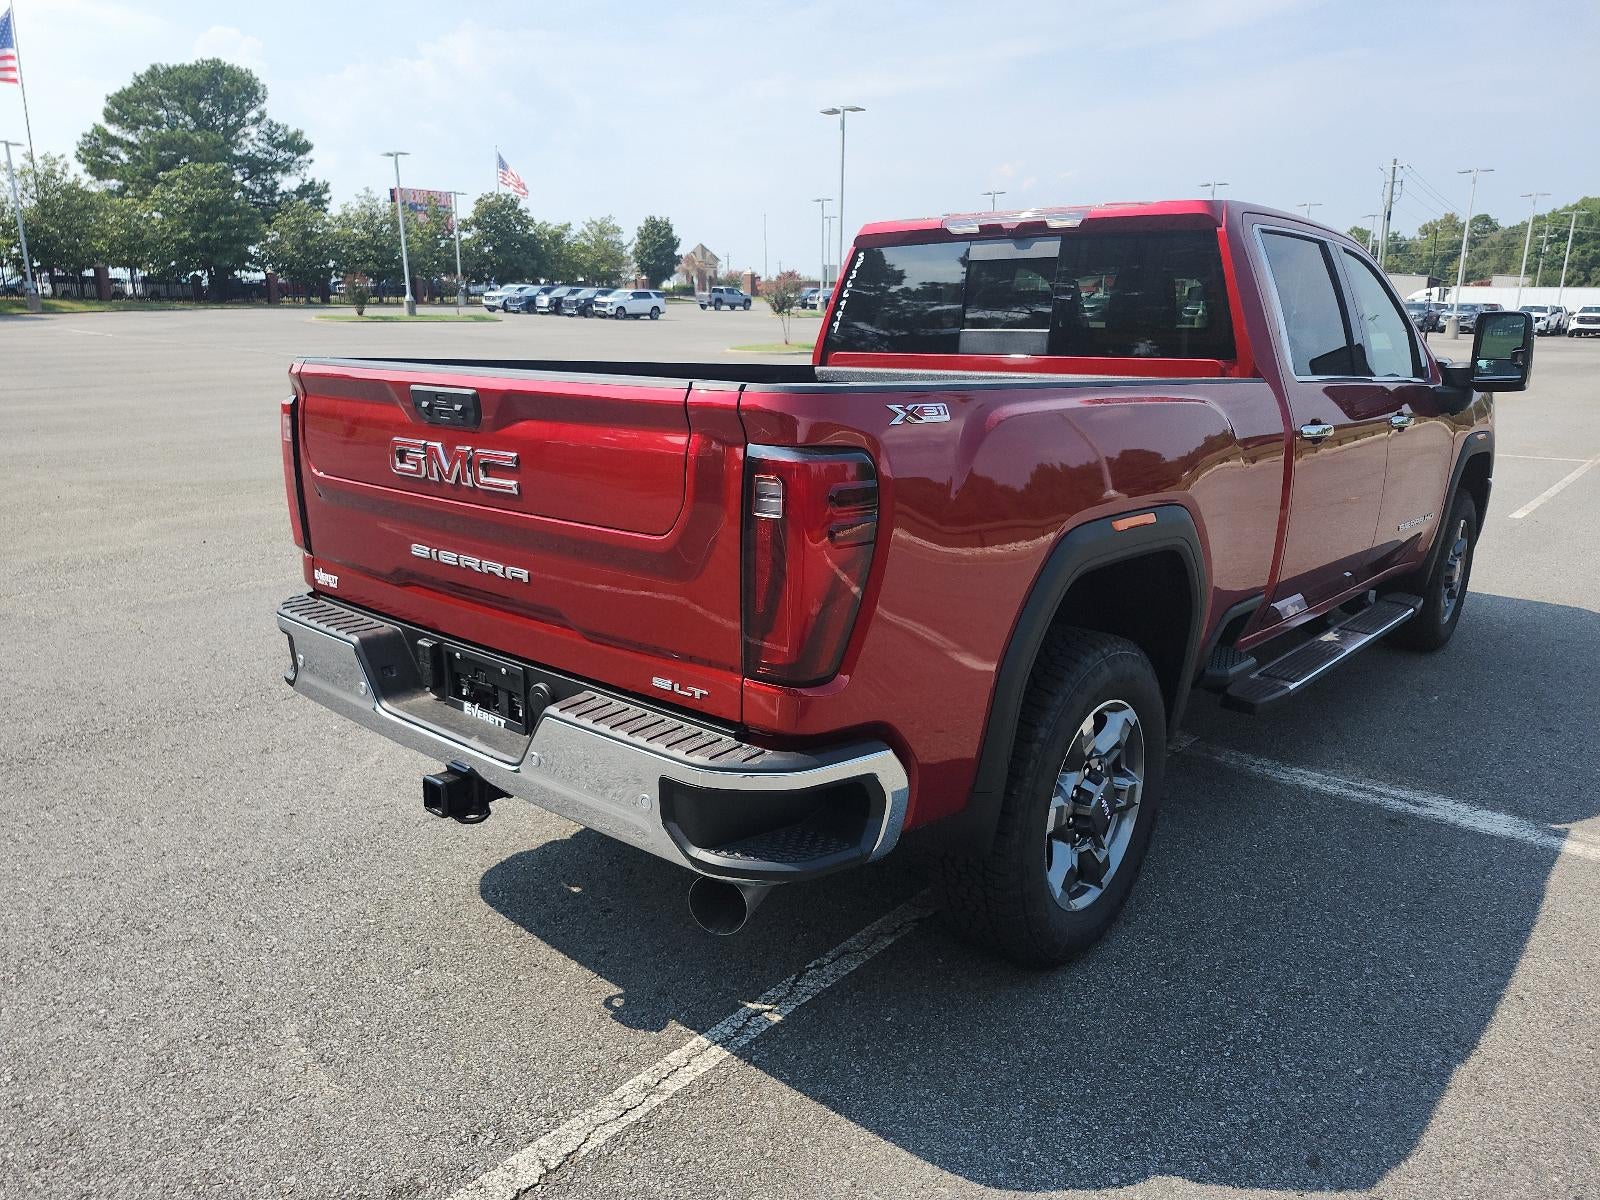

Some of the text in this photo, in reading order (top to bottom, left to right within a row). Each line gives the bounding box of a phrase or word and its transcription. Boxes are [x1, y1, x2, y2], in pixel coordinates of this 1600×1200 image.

[885, 402, 951, 425] X31
[389, 436, 521, 496] GMC
[410, 543, 530, 583] SIERRA
[651, 676, 709, 700] SLT
[463, 700, 506, 729] EVERETT
